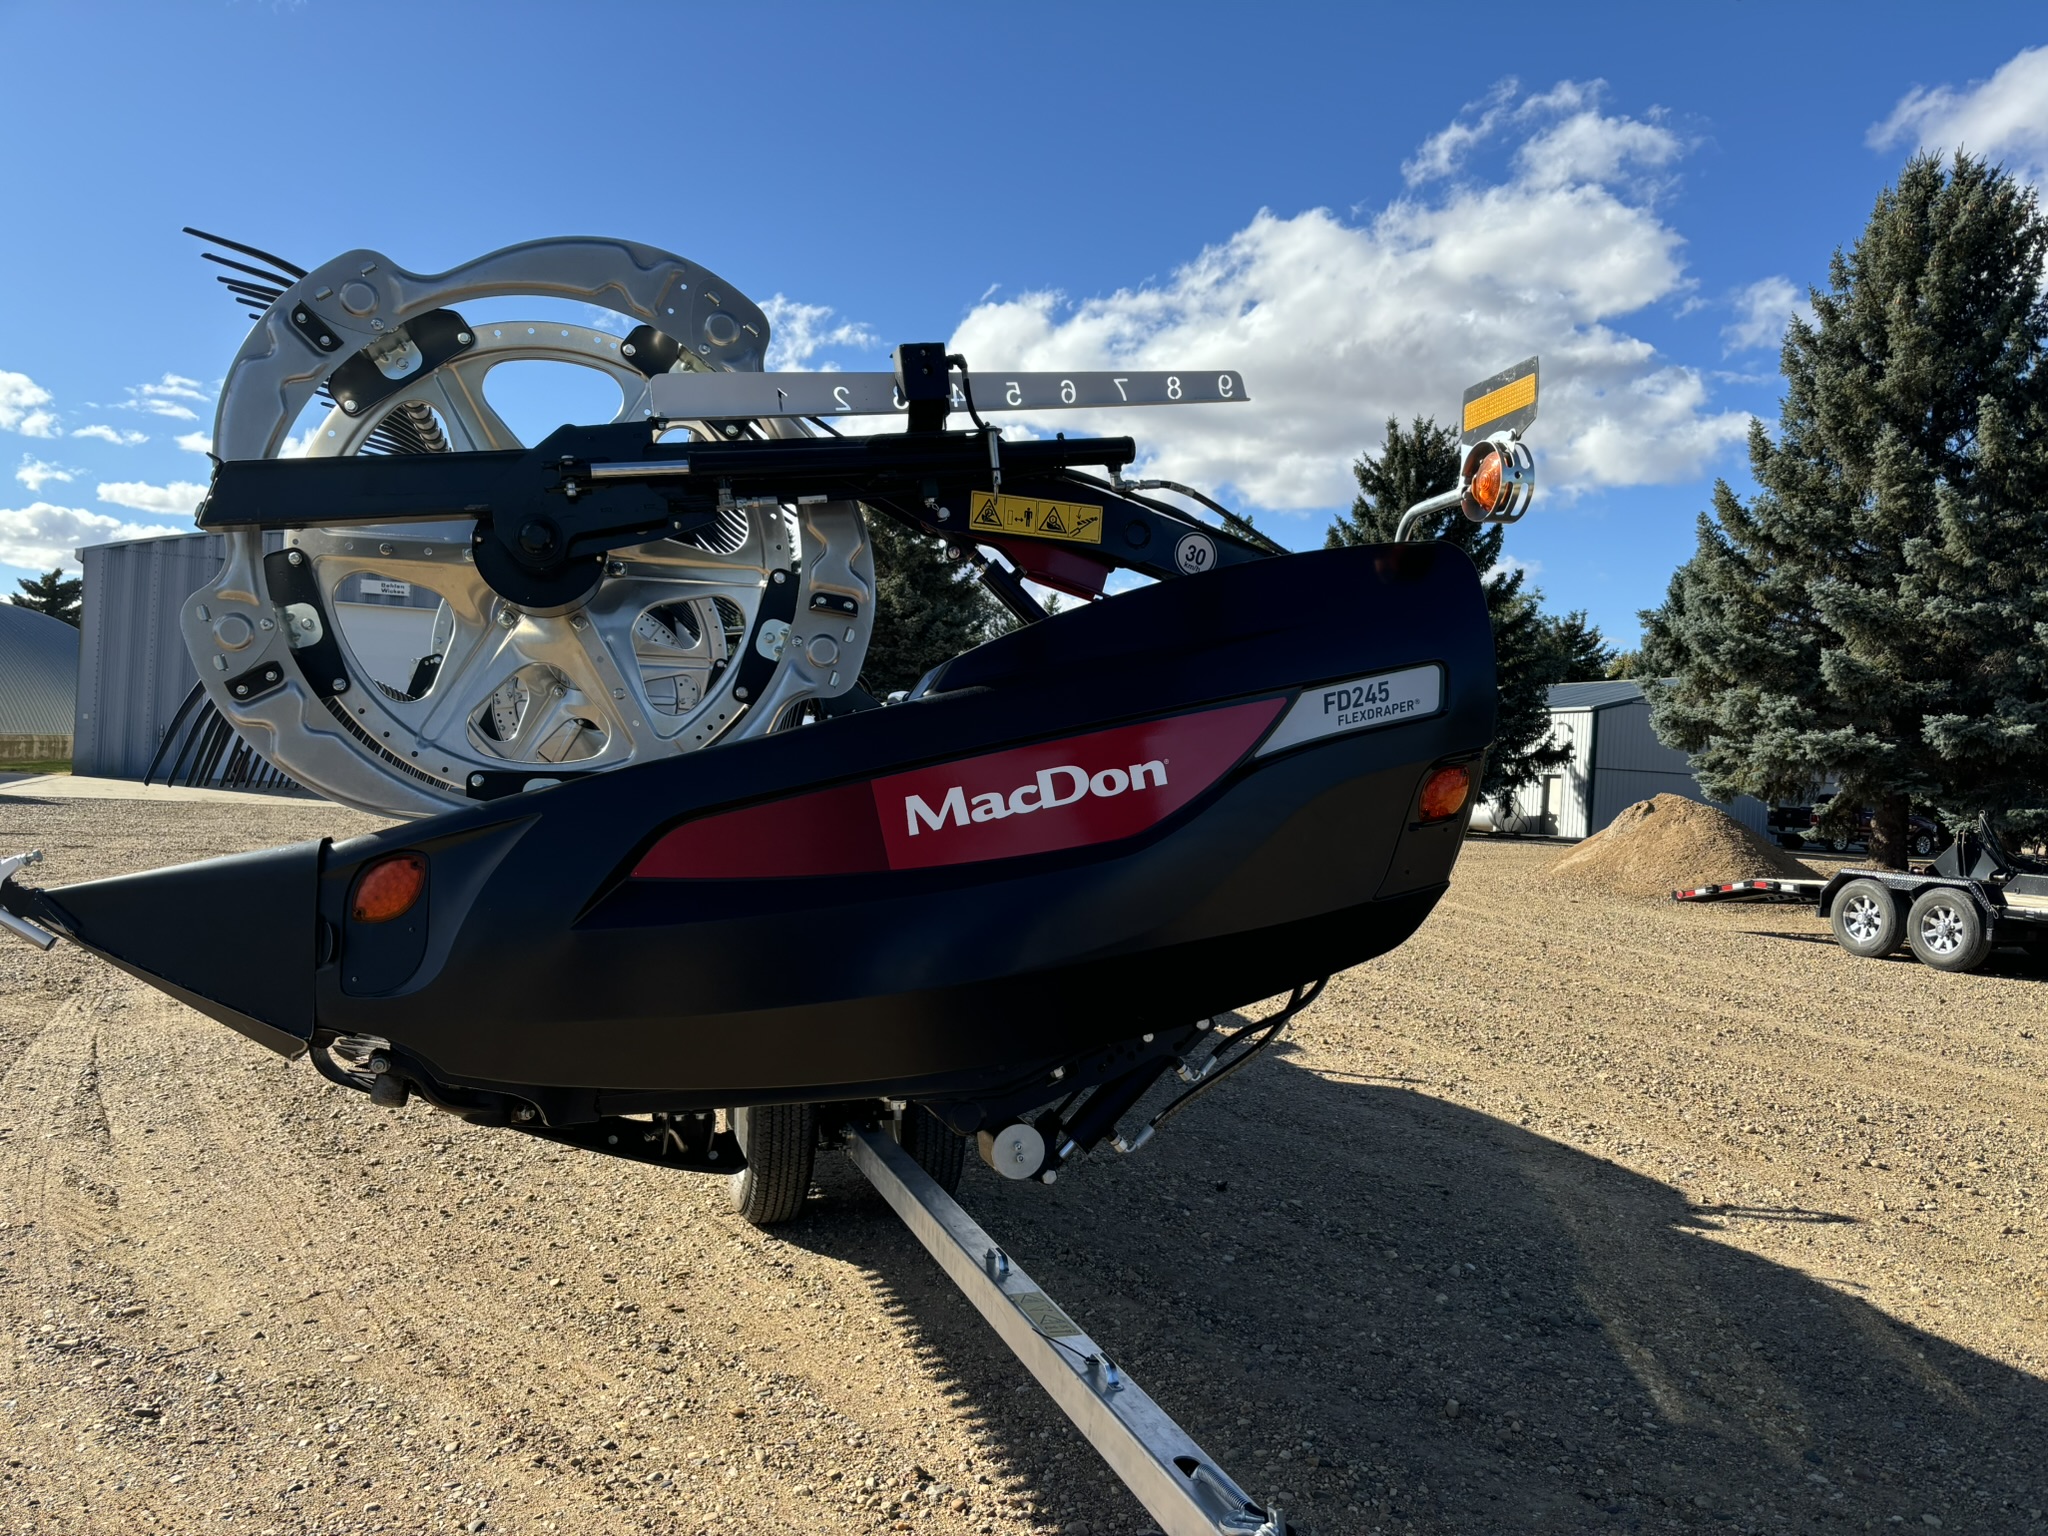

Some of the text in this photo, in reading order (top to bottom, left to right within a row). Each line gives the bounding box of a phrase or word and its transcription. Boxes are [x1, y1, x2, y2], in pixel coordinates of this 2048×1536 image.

[1185, 544, 1207, 566] 30
[1183, 560, 1201, 573] km/h
[1323, 680, 1390, 715] FD245
